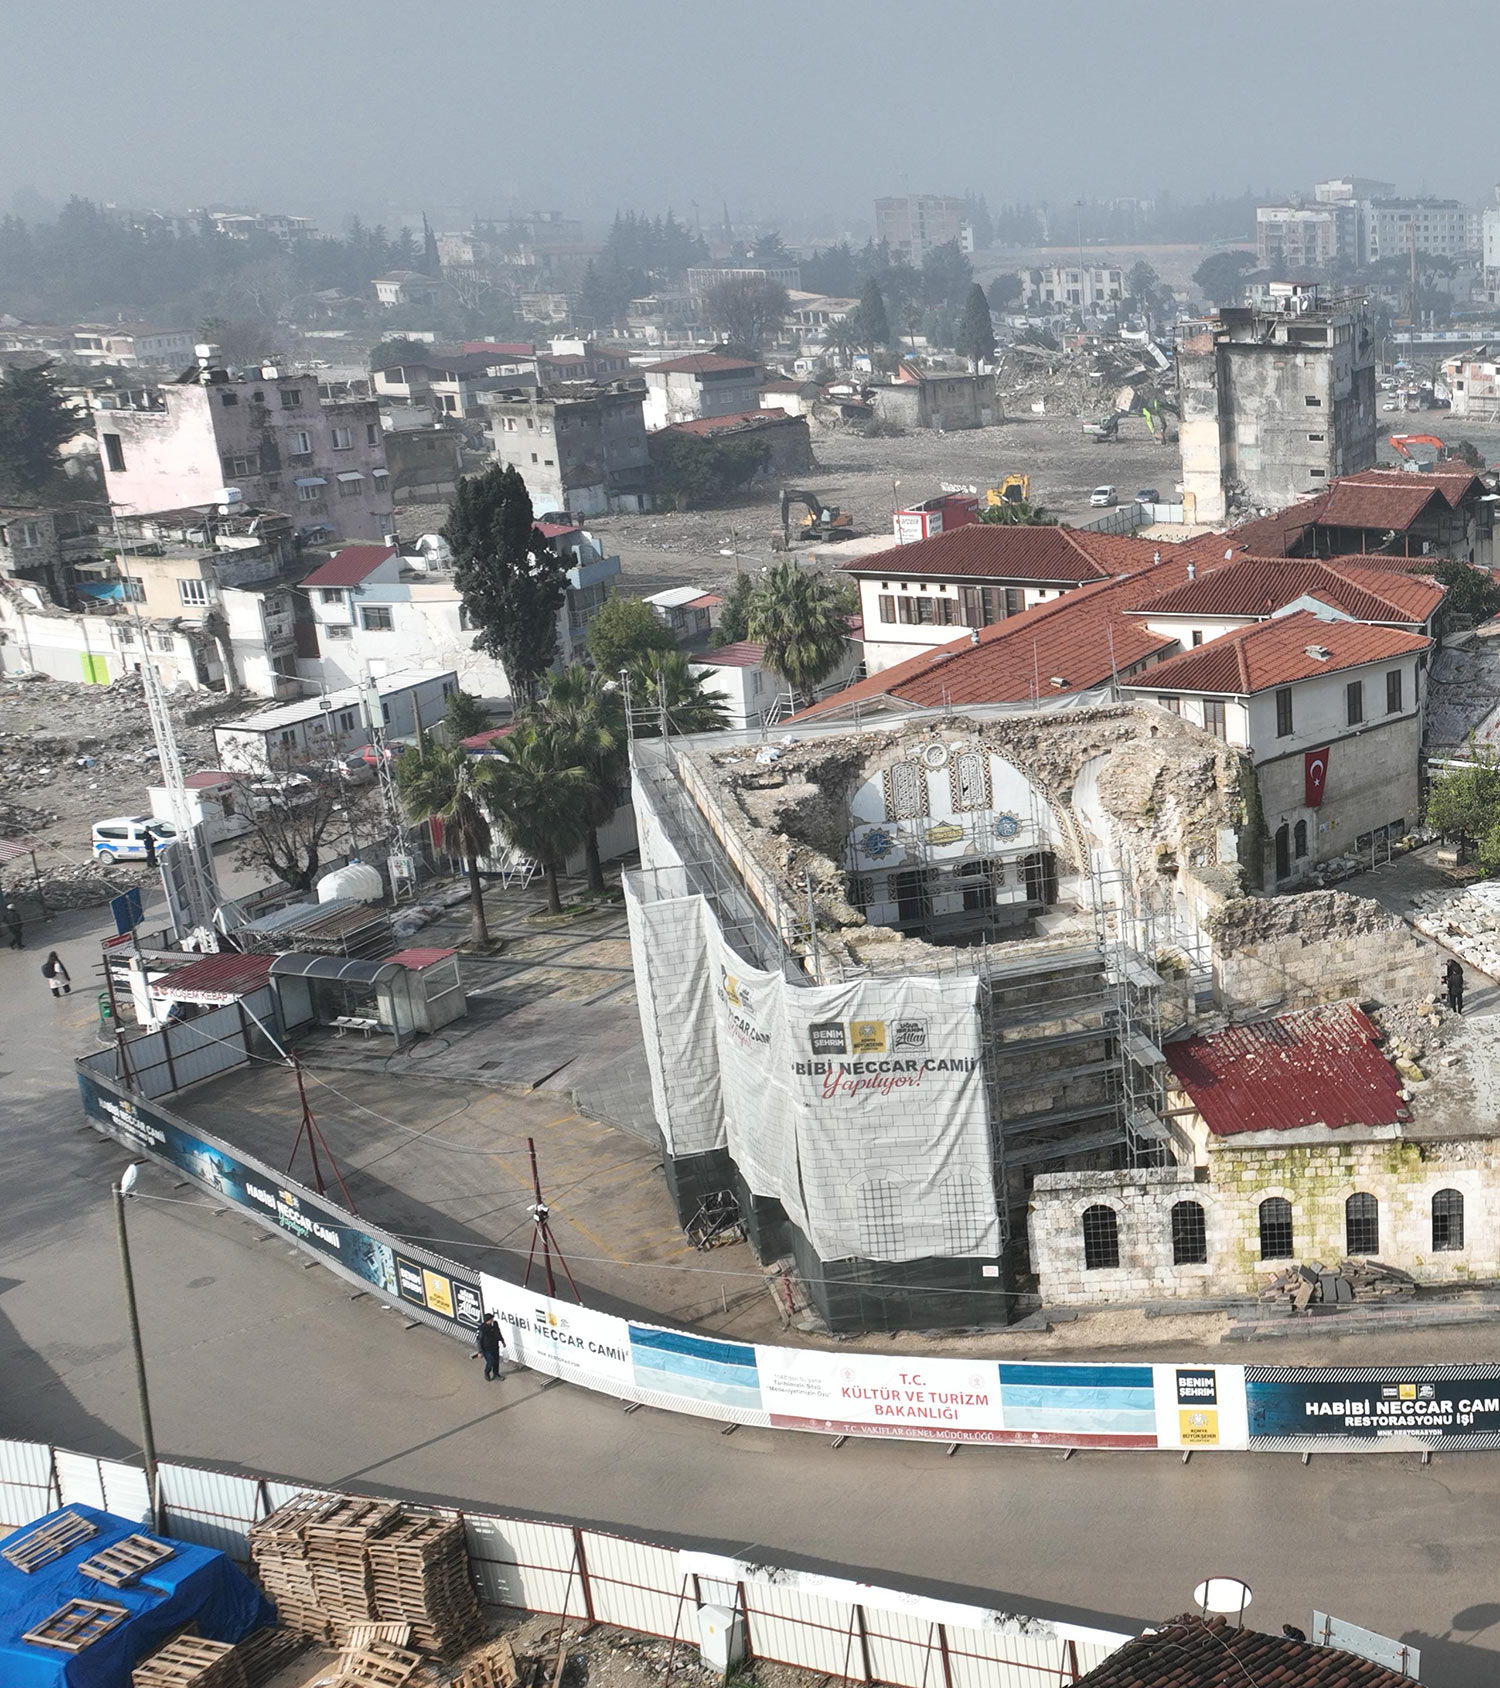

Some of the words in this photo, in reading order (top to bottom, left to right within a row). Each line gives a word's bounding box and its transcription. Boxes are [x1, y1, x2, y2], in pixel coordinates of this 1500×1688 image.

[812, 1029, 843, 1039] BENİM
[814, 1039, 844, 1048] ŞEHRİM
[841, 1059, 920, 1075] NECCAR
[276, 1200, 313, 1232] NECCAR
[492, 1307, 530, 1331] HABİBİ
[534, 1323, 584, 1349] NECCAR
[899, 1373, 927, 1386] T.C.
[1178, 1377, 1214, 1388] BENİM
[841, 1386, 901, 1402] KÜLTÜR
[905, 1390, 925, 1403] VE
[931, 1391, 989, 1407] TURİZM
[1179, 1387, 1214, 1398] ŞEHRİM
[874, 1403, 959, 1420] BAKANLIĞI
[1306, 1399, 1370, 1415] HABİBİ
[1376, 1400, 1453, 1415] NECCAR
[1345, 1415, 1452, 1427] RESTORASYONU
[1456, 1412, 1474, 1426] İŞİ
